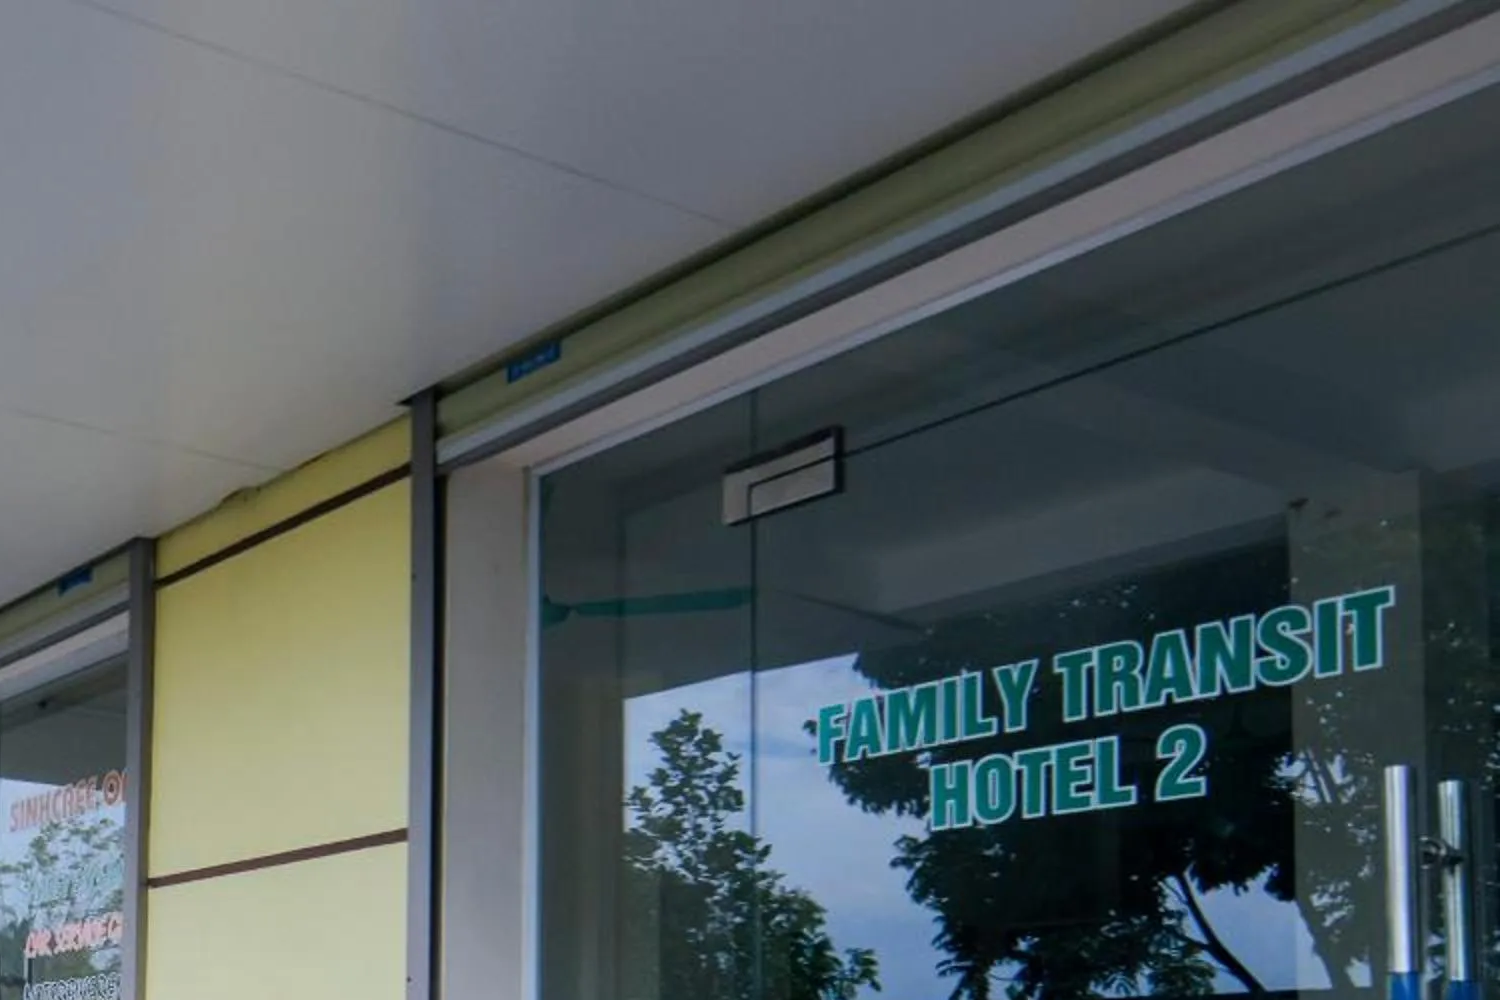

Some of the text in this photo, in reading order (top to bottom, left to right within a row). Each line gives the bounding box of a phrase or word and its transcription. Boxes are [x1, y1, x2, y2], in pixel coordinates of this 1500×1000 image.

[816, 584, 1396, 767] FAMILY TRANSIT
[928, 722, 1209, 832] HOTEL 2
